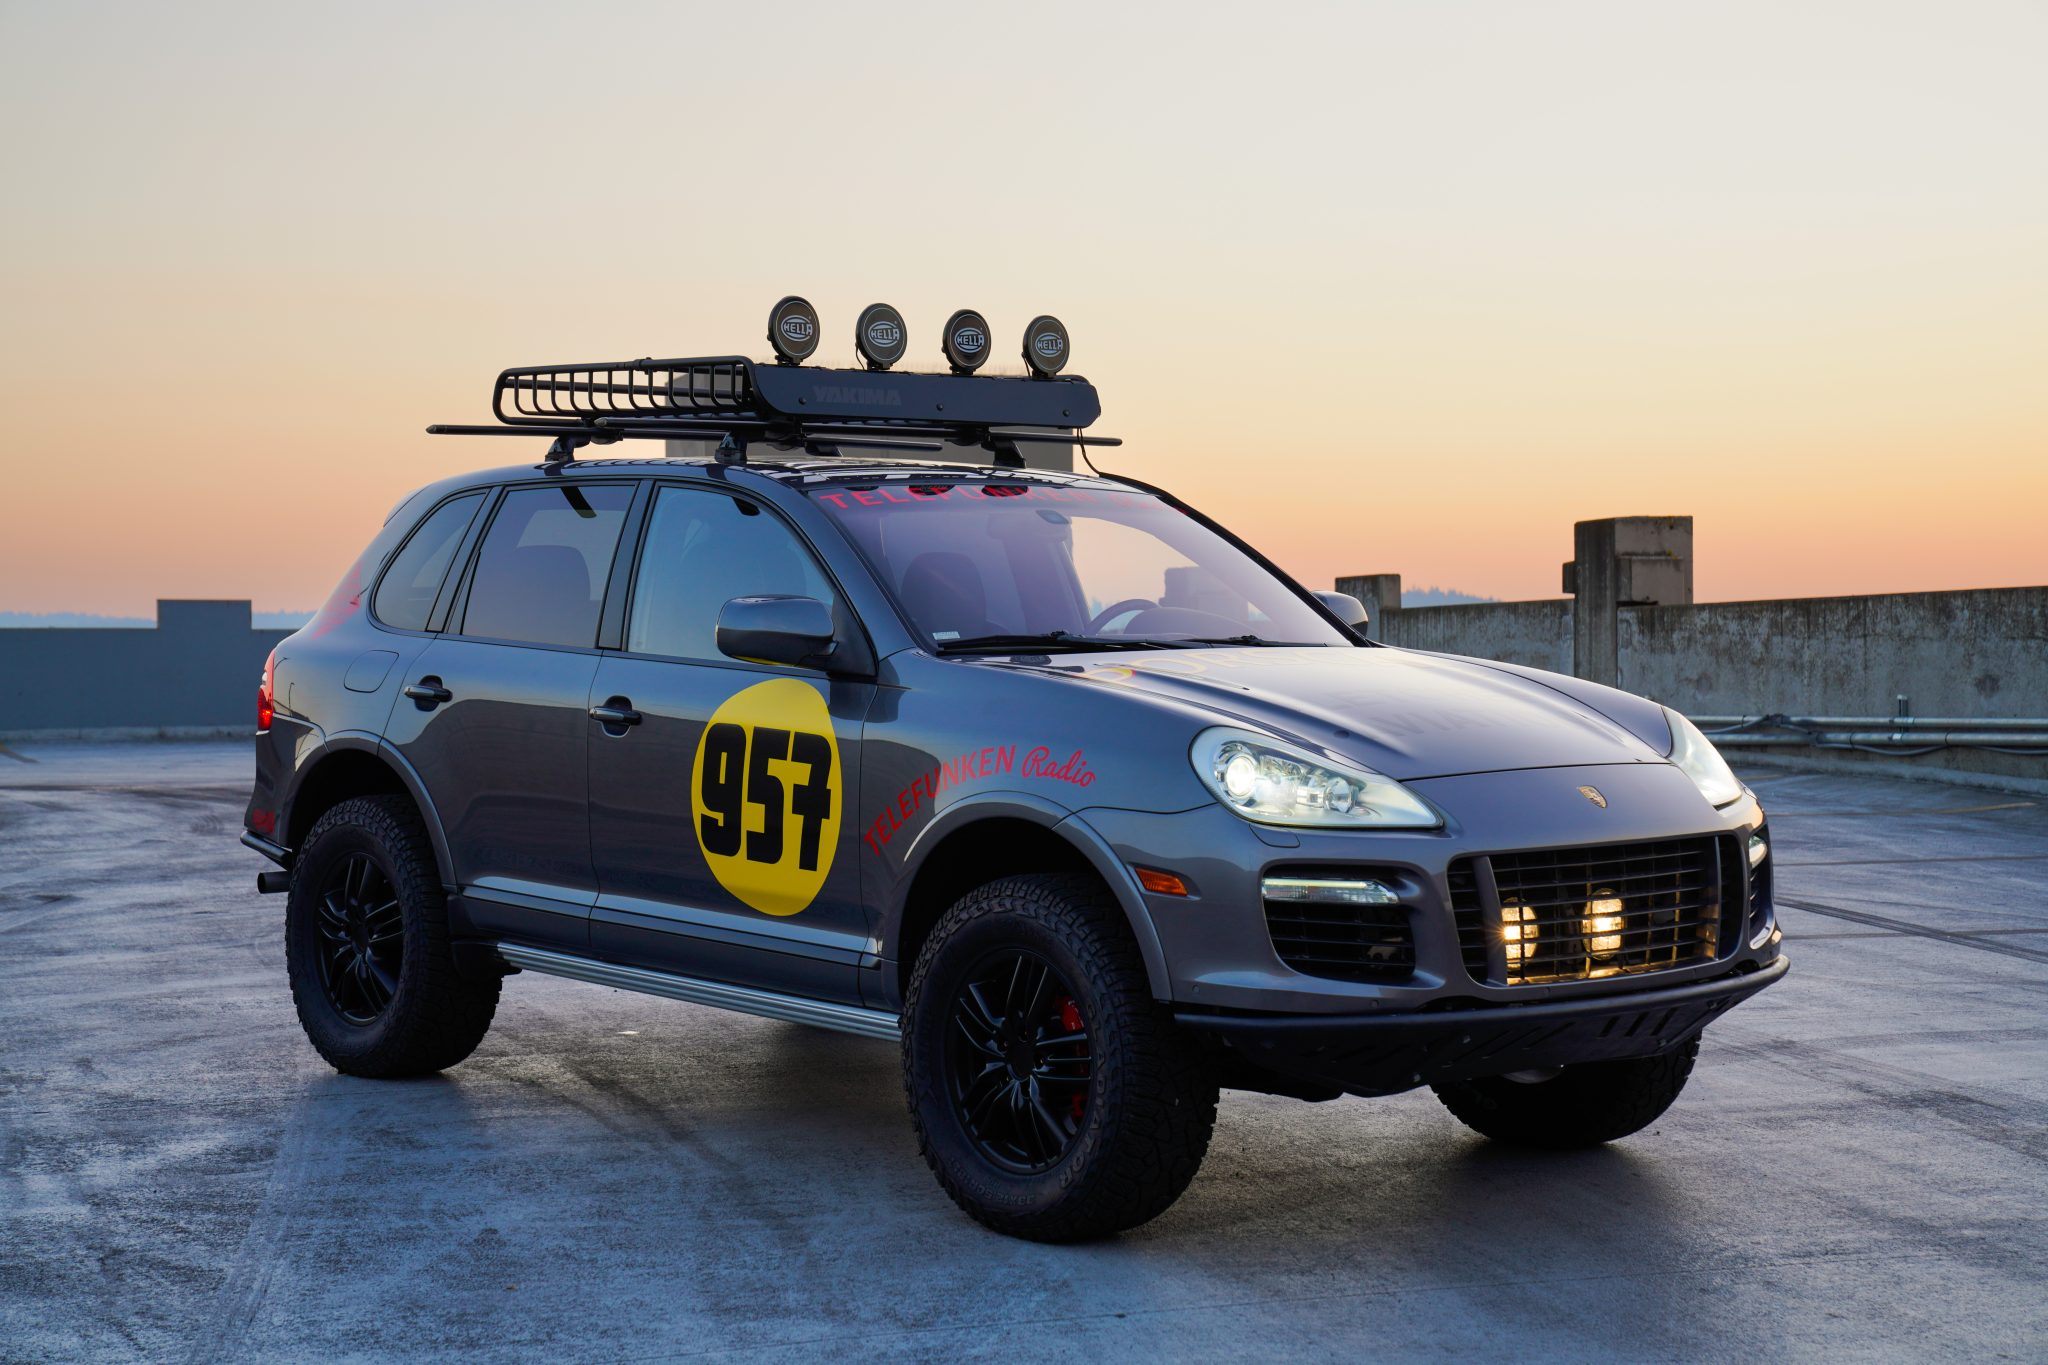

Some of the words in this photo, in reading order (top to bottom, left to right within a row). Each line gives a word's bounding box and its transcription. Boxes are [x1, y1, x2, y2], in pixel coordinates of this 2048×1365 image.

[782, 322, 813, 336] HELLA
[870, 328, 900, 341] HELLA
[956, 333, 985, 347] HELLA
[1037, 338, 1063, 350] HELLA
[812, 384, 902, 406] YAKIMA
[700, 722, 832, 872] 957
[863, 744, 1017, 857] TELEFUNKEN
[1021, 745, 1096, 788] Radio
